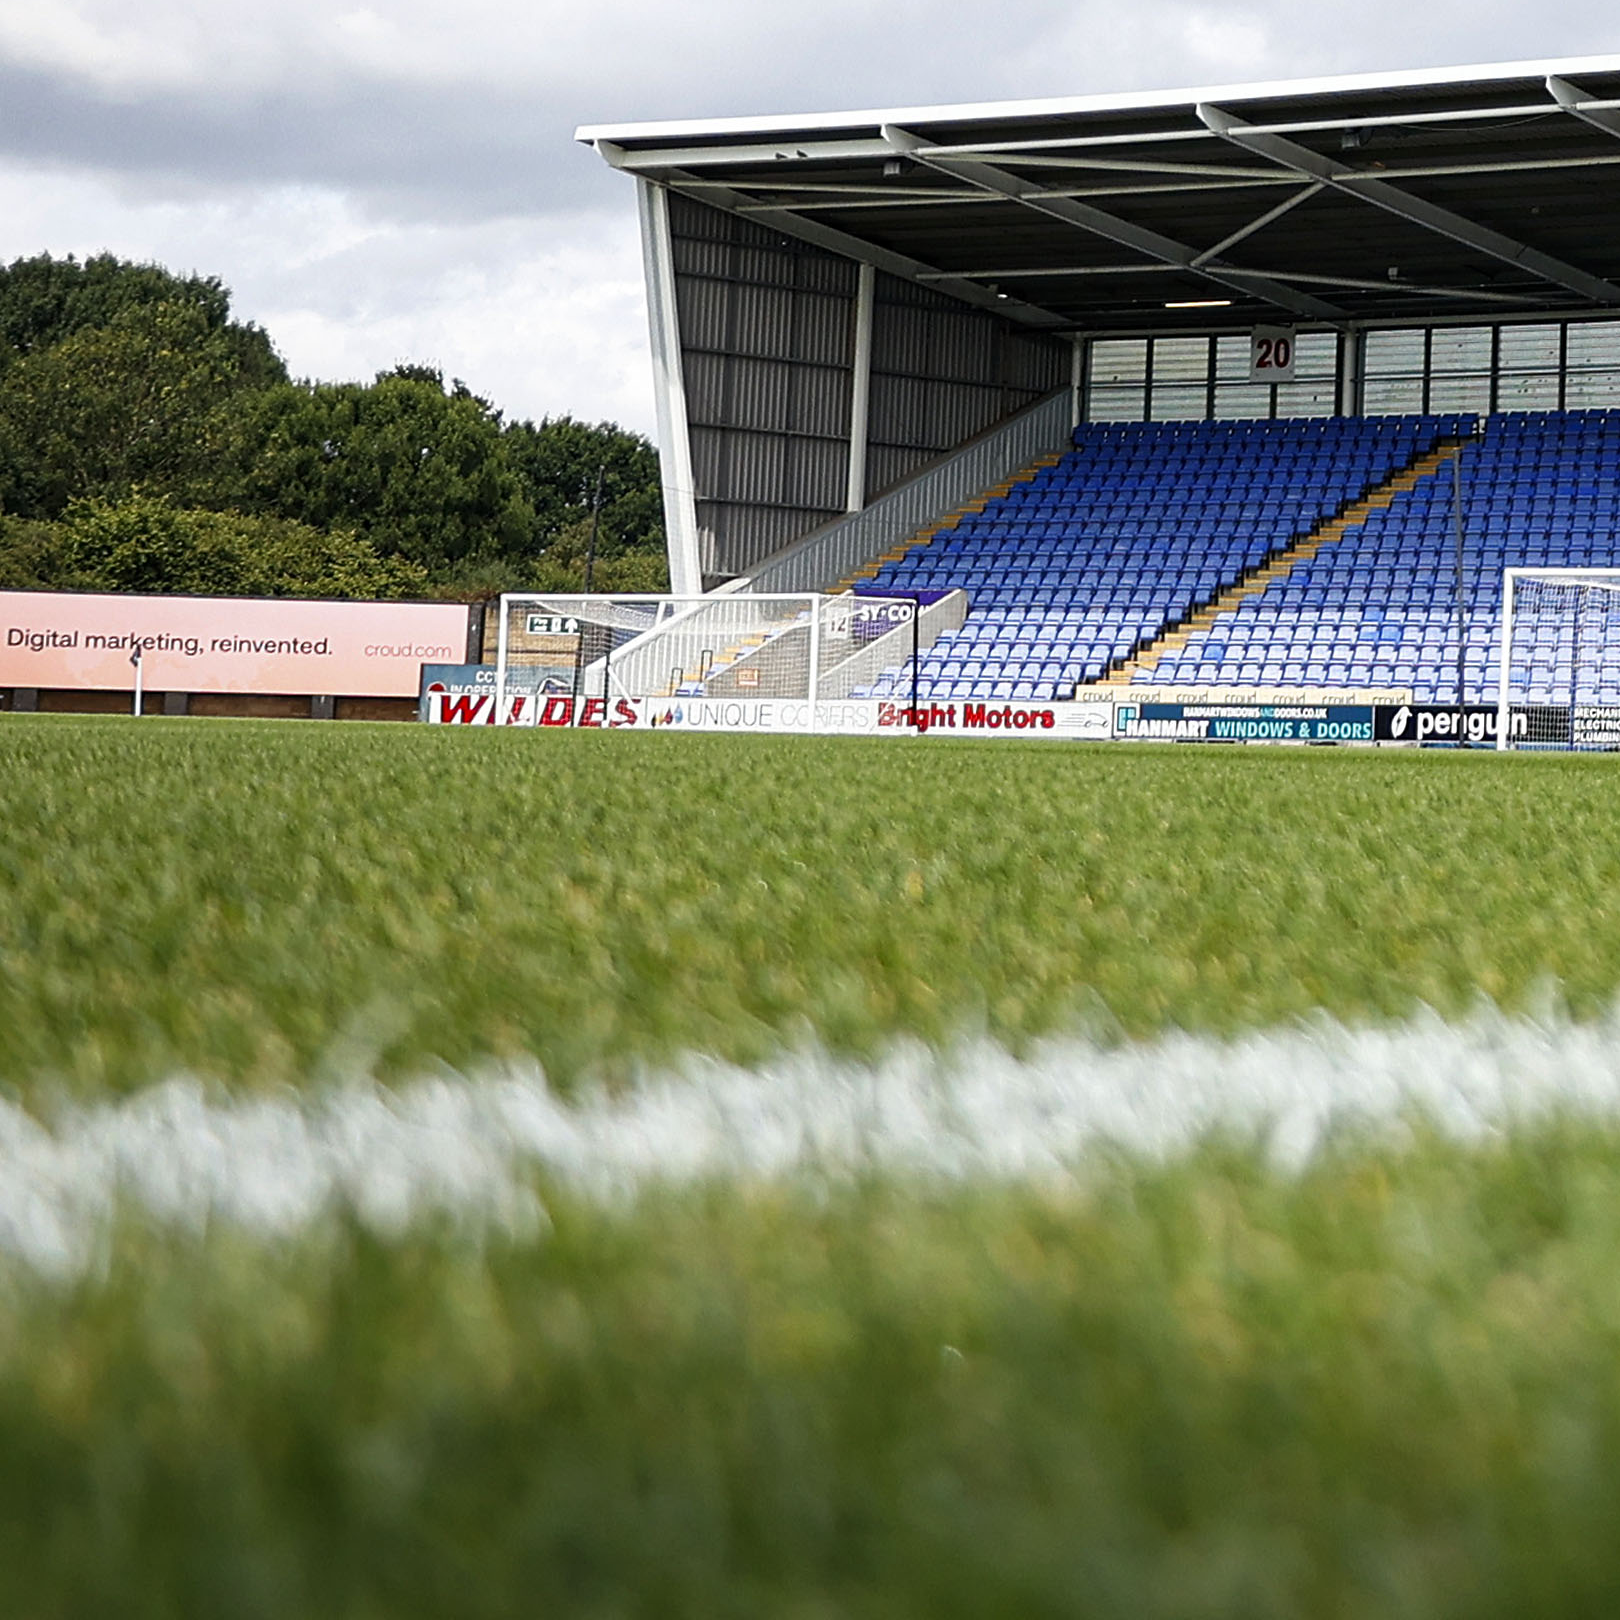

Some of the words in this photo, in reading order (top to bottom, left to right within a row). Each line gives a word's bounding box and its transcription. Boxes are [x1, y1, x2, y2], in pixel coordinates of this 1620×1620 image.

[1255, 338, 1290, 369] 20
[830, 617, 847, 632] 12
[6, 628, 79, 652] Digital
[85, 631, 205, 656] marketing,
[210, 634, 334, 656] reinvented.
[364, 642, 452, 658] croud.com
[464, 685, 532, 694] OPERTION
[687, 703, 773, 727] UNIQUE
[962, 702, 1055, 729] Motors
[1126, 719, 1209, 737] HANMART
[1214, 721, 1293, 738] WINDOWS
[1299, 721, 1310, 737] &
[1316, 722, 1372, 738] DOORS
